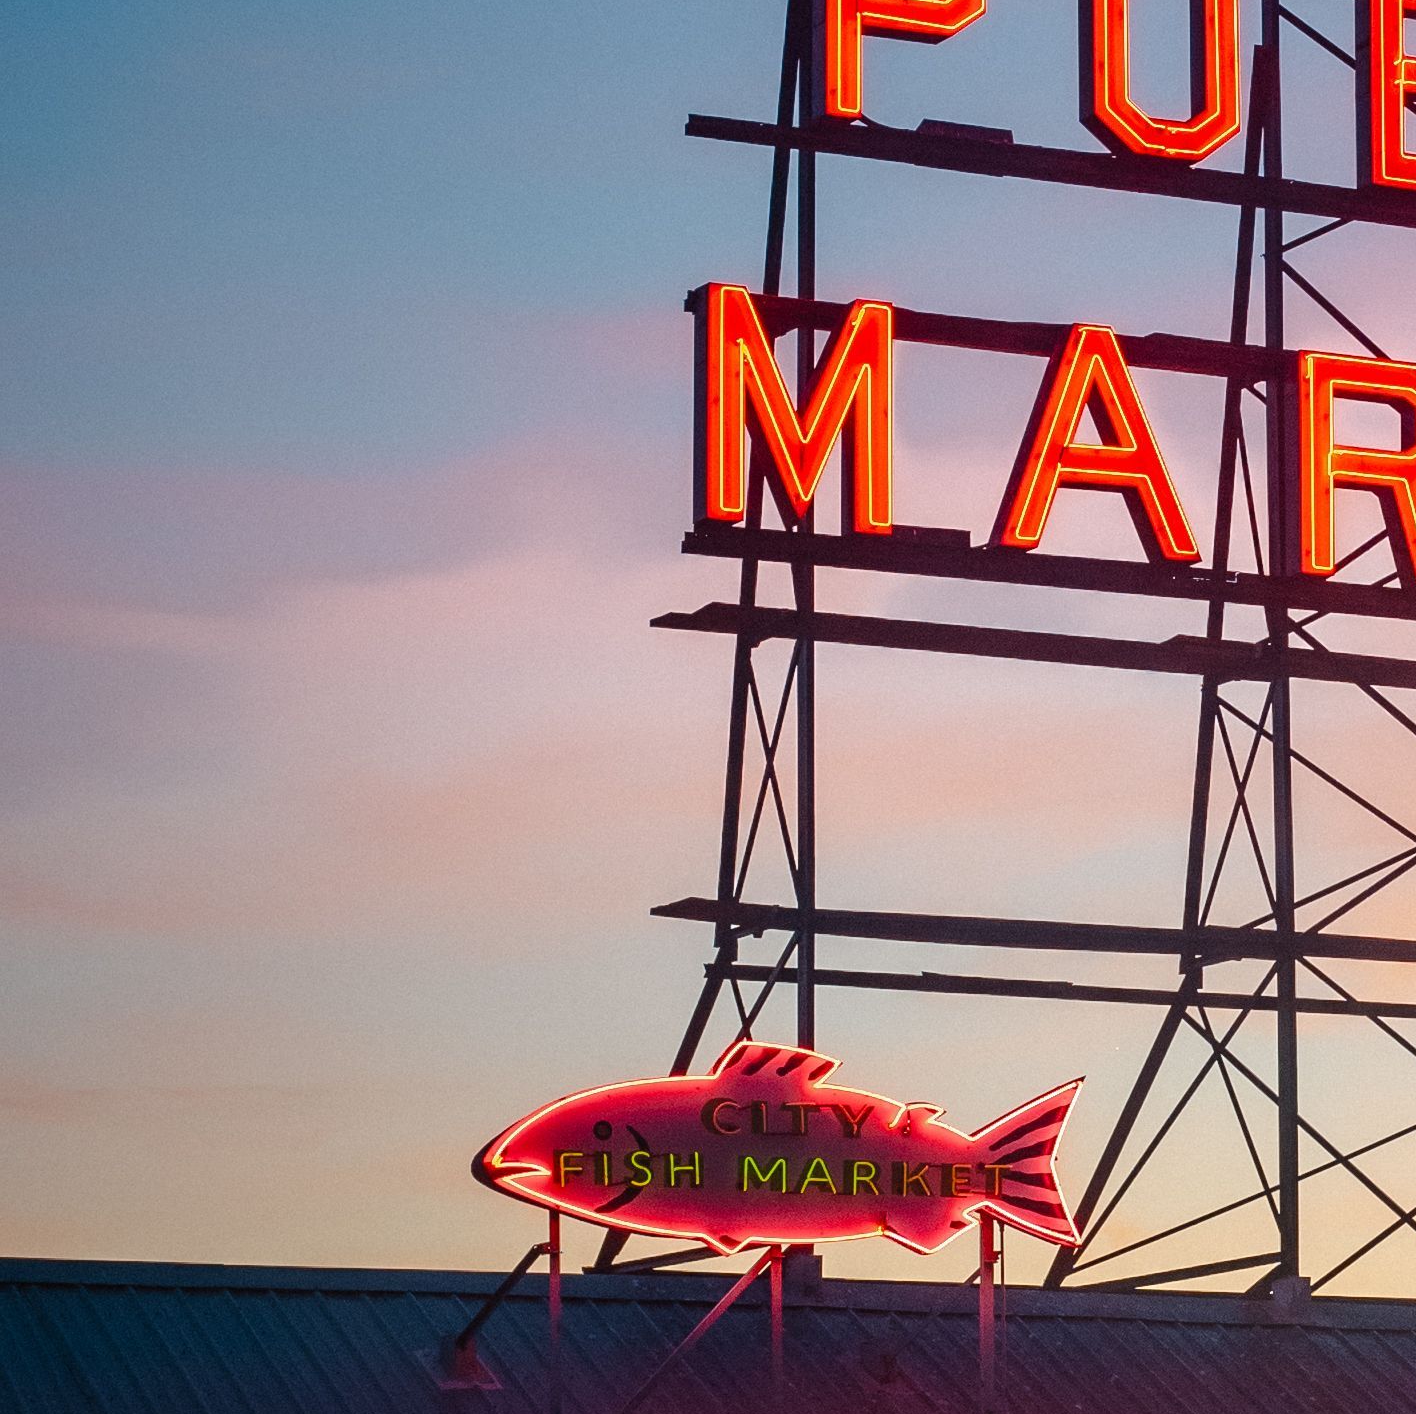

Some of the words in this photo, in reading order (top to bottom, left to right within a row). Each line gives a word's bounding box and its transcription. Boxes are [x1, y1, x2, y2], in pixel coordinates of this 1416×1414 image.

[703, 1097, 876, 1138] CITY
[553, 1149, 700, 1189] FISH
[738, 1155, 1012, 1199] MARKET
